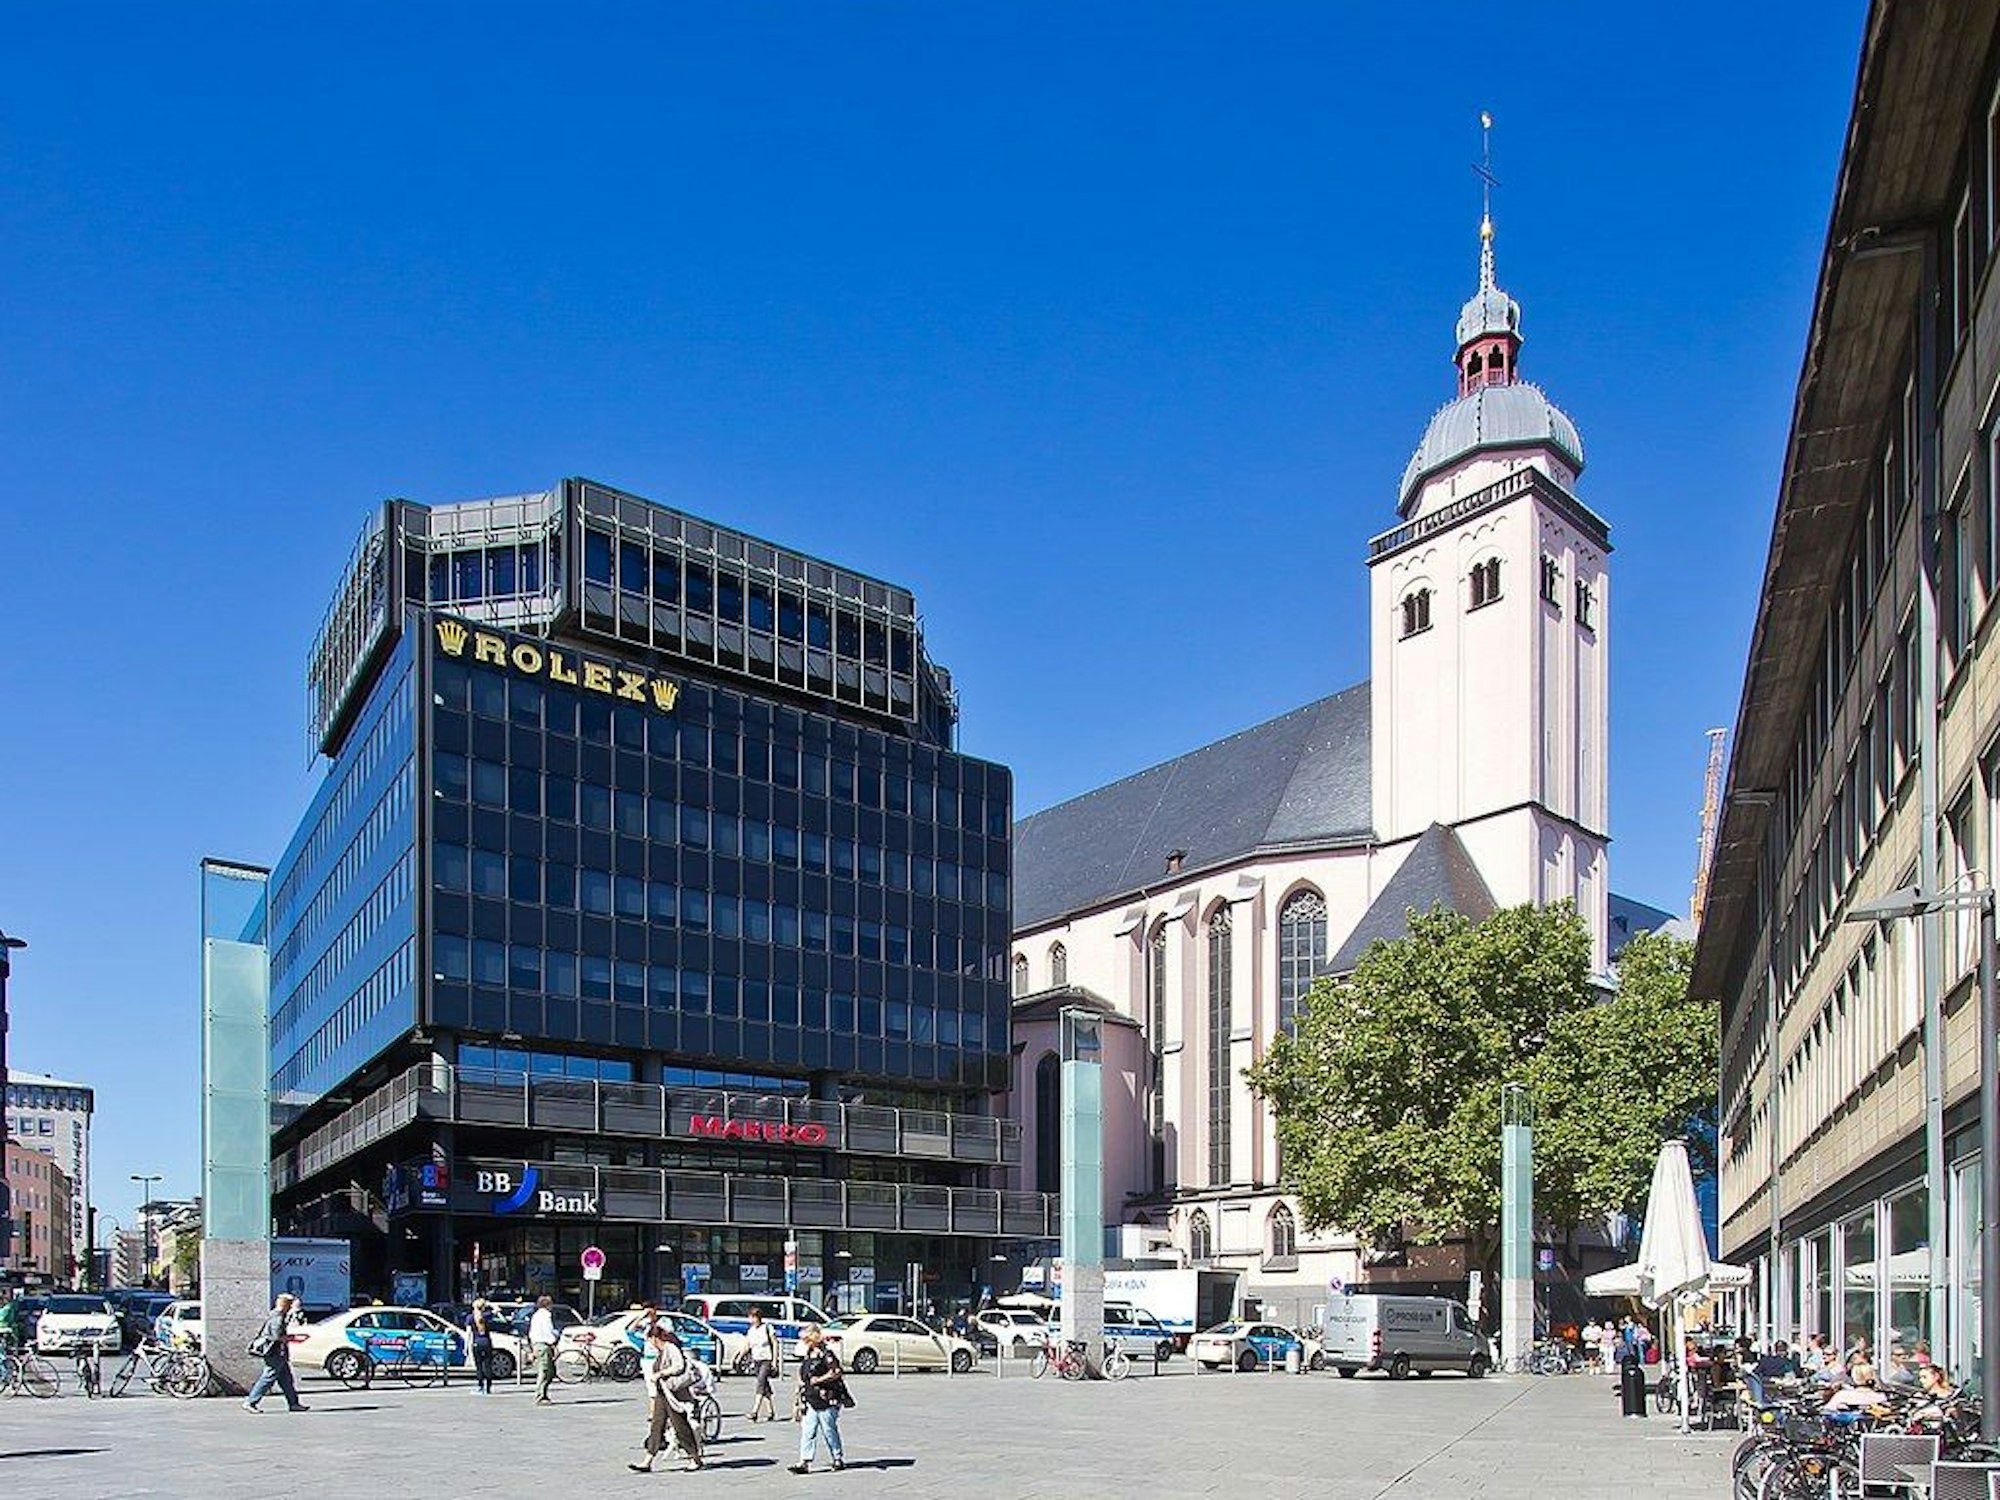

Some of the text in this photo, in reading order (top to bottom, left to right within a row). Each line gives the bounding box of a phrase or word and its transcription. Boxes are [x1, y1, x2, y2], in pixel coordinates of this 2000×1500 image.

[475, 631, 646, 702] ROLEX
[689, 1115, 826, 1145] MAREDO
[476, 1171, 511, 1193] BB
[538, 1190, 597, 1213] Bank
